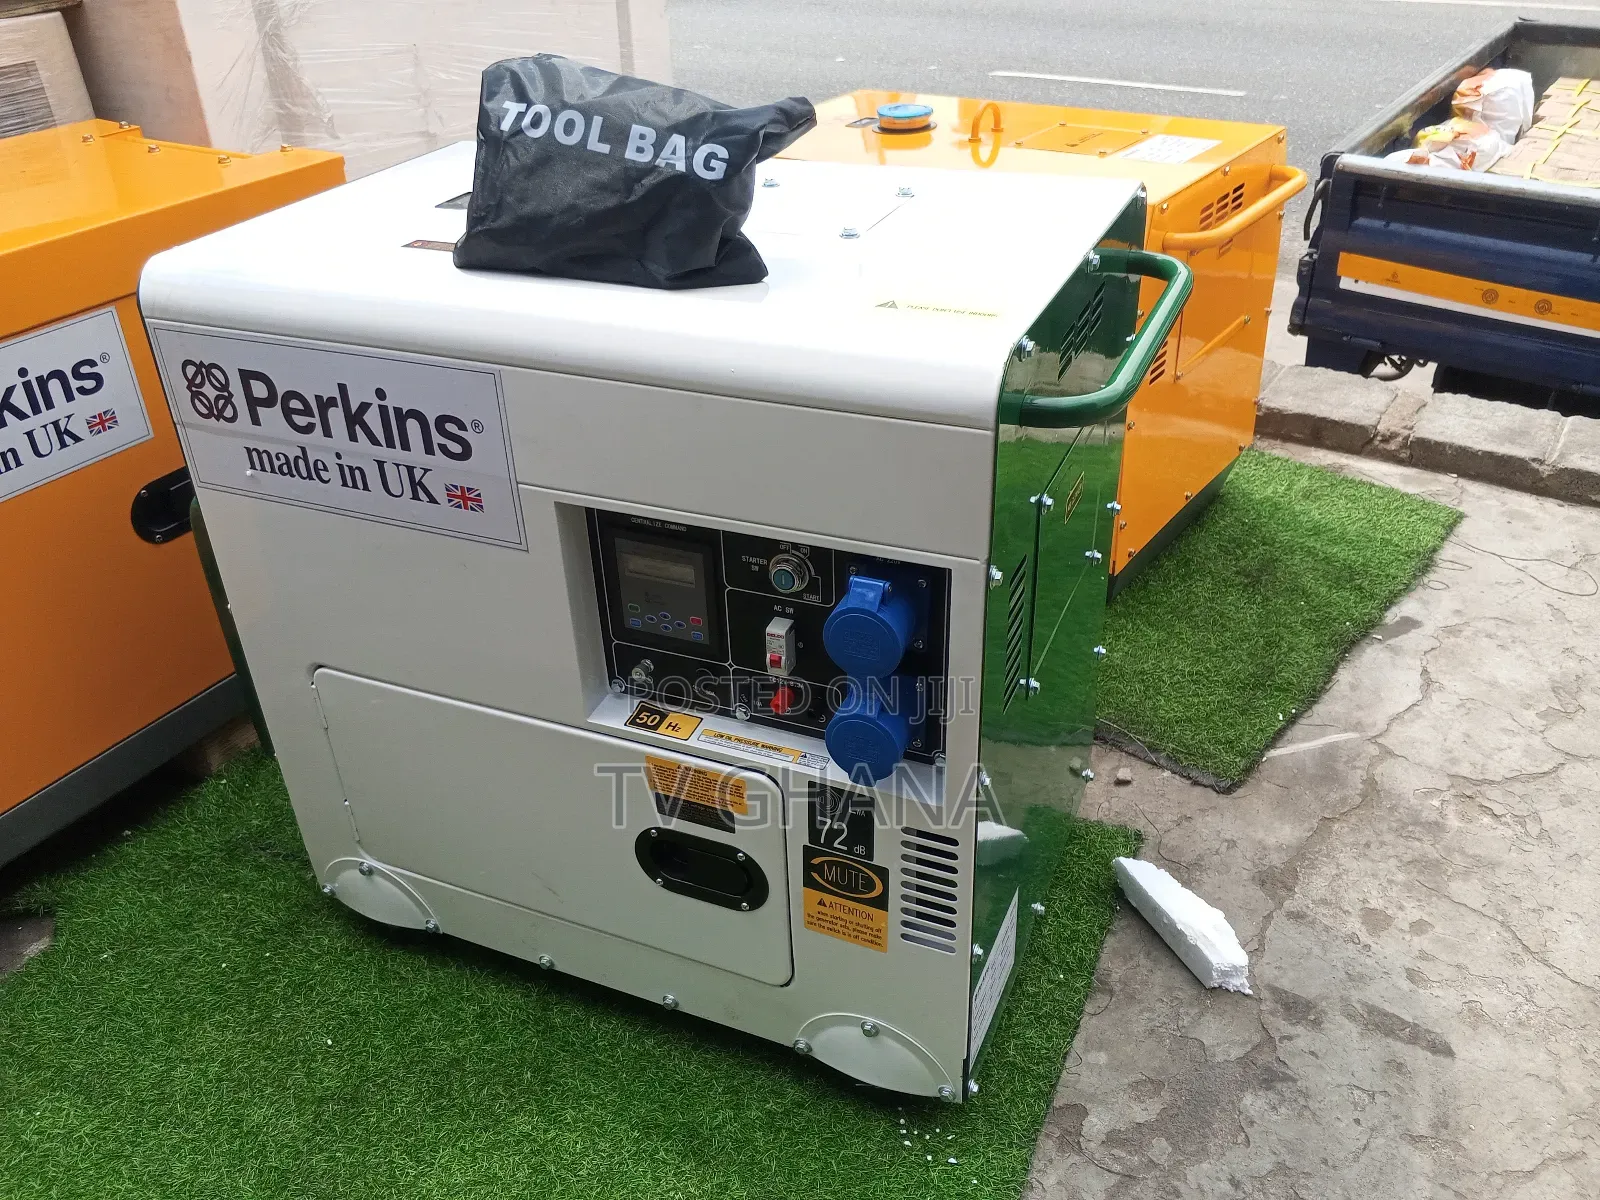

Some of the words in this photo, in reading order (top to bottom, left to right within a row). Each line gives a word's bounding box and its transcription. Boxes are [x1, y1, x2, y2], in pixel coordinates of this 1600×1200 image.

[500, 101, 611, 155] TOOL
[624, 124, 730, 181] BAG
[23, 413, 85, 459] UK
[243, 445, 331, 485] made
[335, 451, 371, 493] in
[373, 458, 441, 506] UK
[664, 523, 687, 532] COMMAND
[741, 555, 767, 565] STARTER
[751, 564, 759, 572] SW
[803, 593, 819, 601] START
[773, 604, 782, 612] AC
[785, 606, 794, 615] SW
[635, 712, 661, 726] 50
[665, 721, 682, 733] Hz
[734, 737, 760, 747] PRESSURE
[761, 744, 784, 753] WARNING
[817, 816, 848, 851] 72
[853, 844, 866, 856] dB
[823, 862, 869, 892] MUTE
[828, 900, 874, 922] ATTENTION
[816, 916, 839, 927] generator
[852, 927, 868, 936] please
[818, 922, 826, 930] the
[826, 926, 841, 935] switch
[830, 914, 848, 925] starting
[855, 922, 873, 933] shutting
